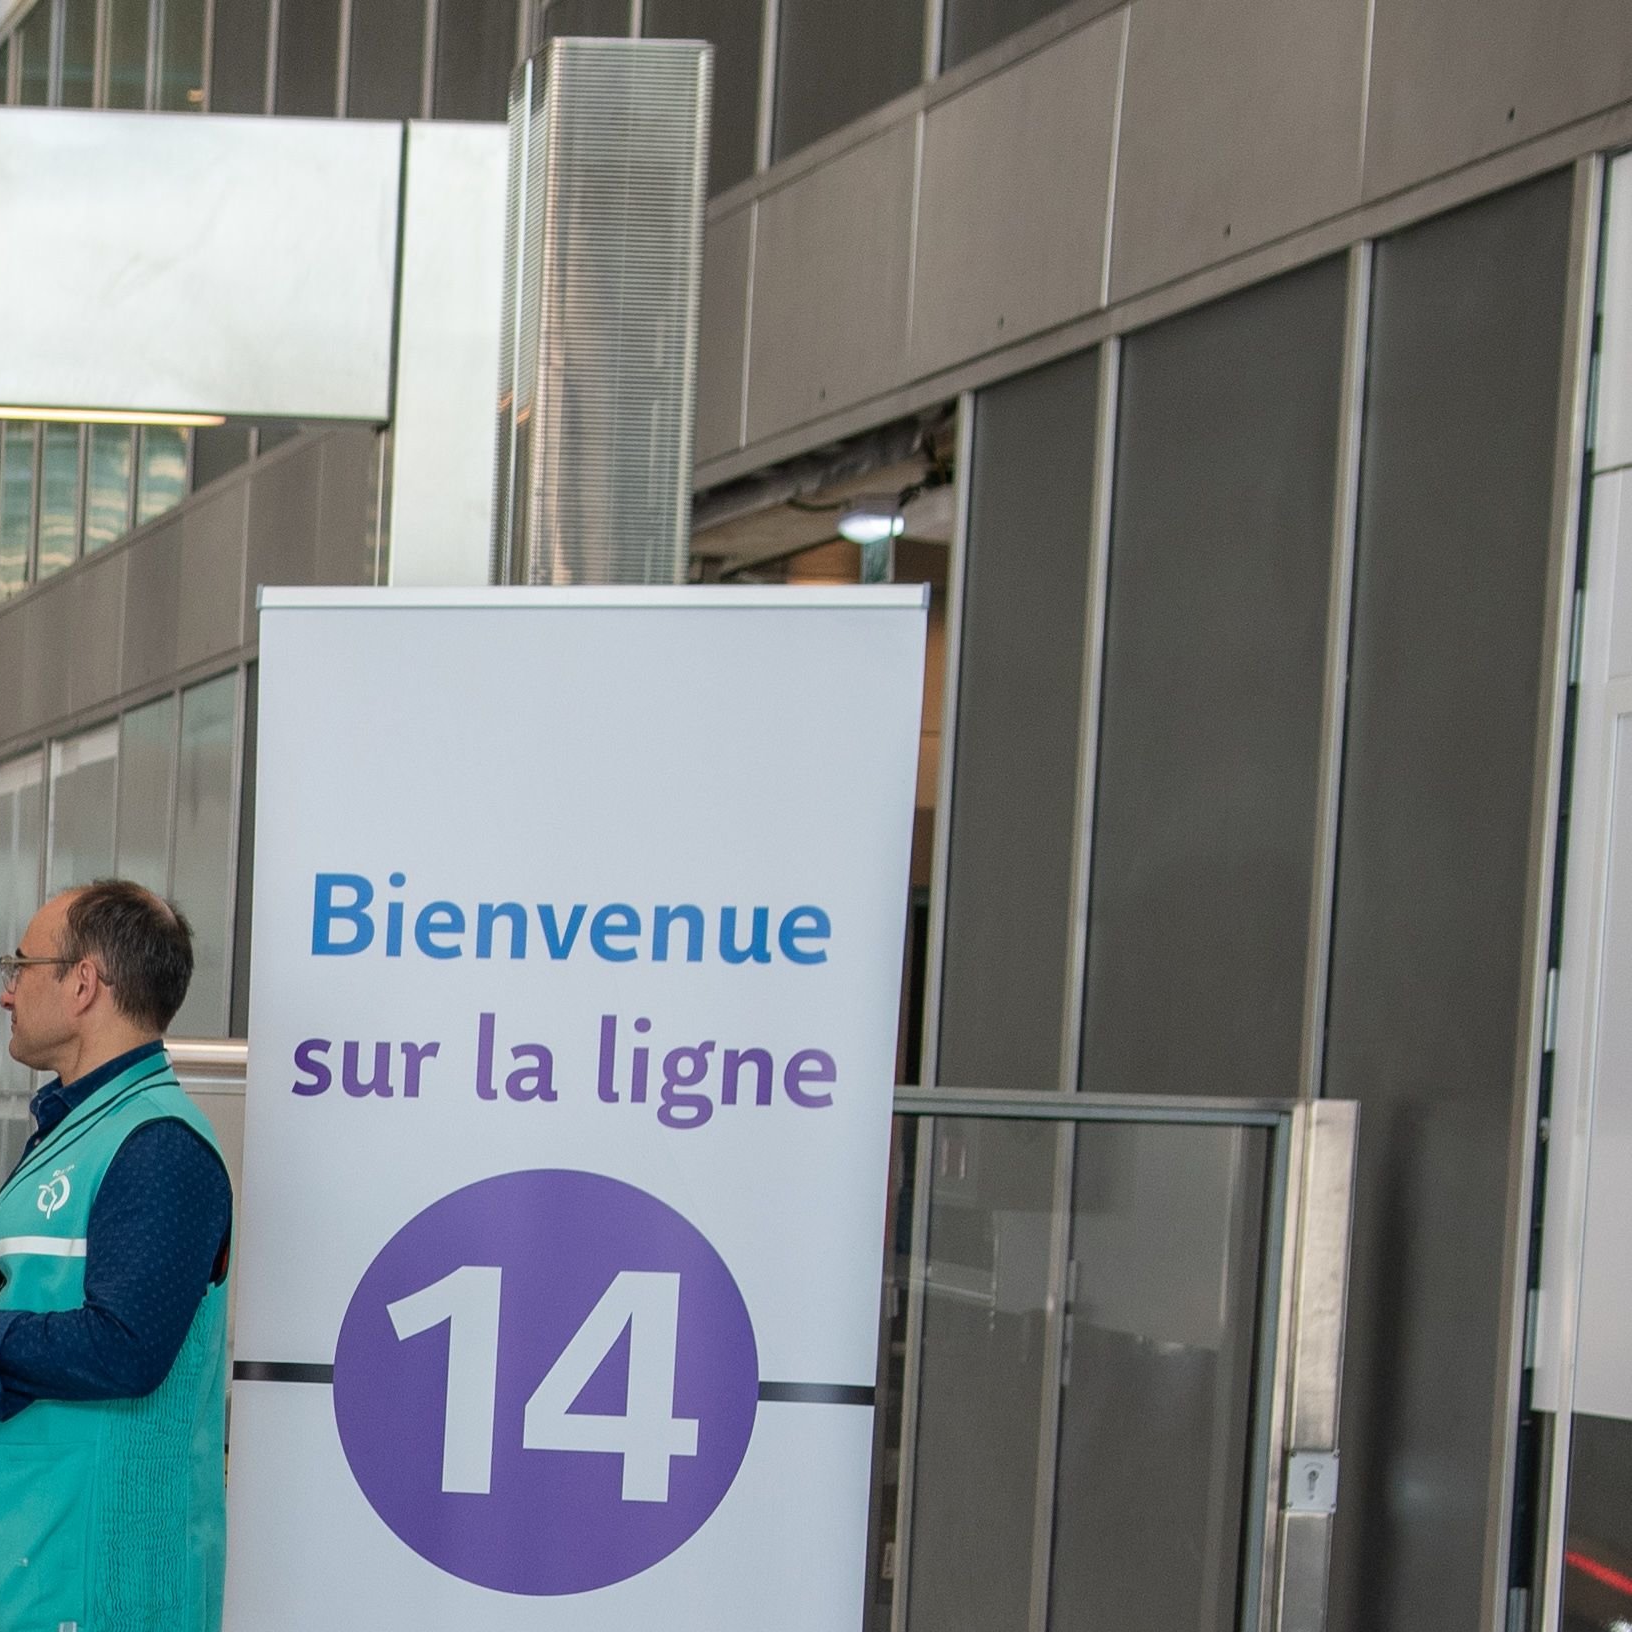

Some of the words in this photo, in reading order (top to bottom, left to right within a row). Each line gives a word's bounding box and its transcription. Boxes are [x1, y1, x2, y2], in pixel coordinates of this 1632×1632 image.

[310, 872, 832, 965] Bienvenue
[291, 1038, 440, 1098] sur
[475, 1012, 558, 1102] la
[597, 1014, 838, 1129] ligne
[386, 1264, 700, 1502] 14
